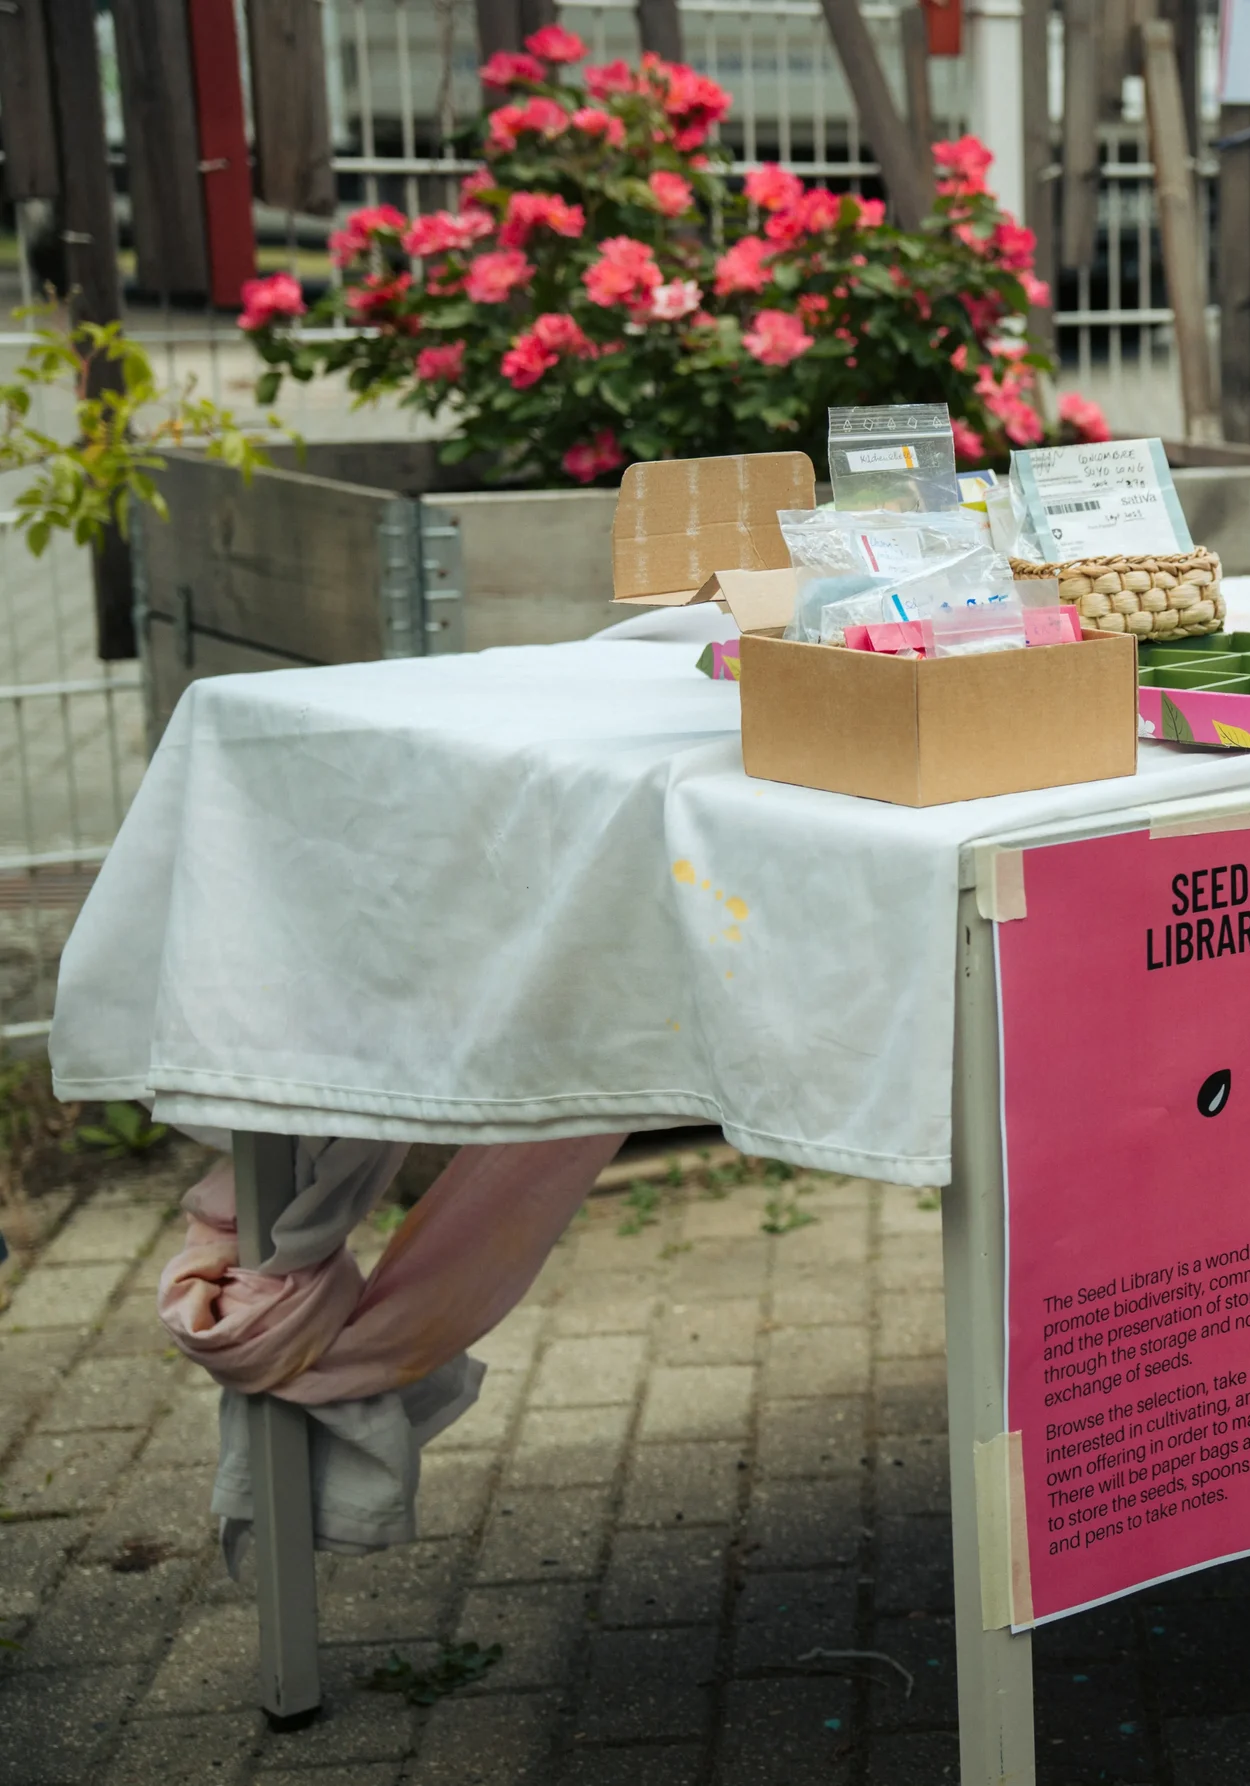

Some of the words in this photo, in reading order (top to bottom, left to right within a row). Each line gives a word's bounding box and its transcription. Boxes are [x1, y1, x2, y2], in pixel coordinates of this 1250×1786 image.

[1120, 490, 1157, 507] sativa
[1171, 863, 1249, 917] SEED
[1043, 1295, 1074, 1314] The
[1077, 1278, 1117, 1305] Seed
[1121, 1266, 1174, 1293] Library
[1177, 1261, 1190, 1277] is
[1192, 1259, 1202, 1273] a
[1043, 1307, 1110, 1343] promote
[1113, 1282, 1205, 1318] biodiversity,
[1043, 1336, 1074, 1361] and
[1078, 1332, 1104, 1351] the
[1107, 1304, 1203, 1347] preservation
[1205, 1294, 1222, 1315] of
[1043, 1351, 1107, 1385] through
[1111, 1346, 1137, 1365] the
[1140, 1328, 1197, 1356] storage
[1200, 1315, 1231, 1339] and
[1044, 1373, 1123, 1408] exchange
[1125, 1362, 1141, 1383] of
[1144, 1351, 1193, 1378] seeds.
[1046, 1412, 1105, 1441] Browse
[1107, 1403, 1134, 1423] the
[1136, 1382, 1209, 1414] selection,
[1212, 1370, 1247, 1391] take
[1046, 1425, 1125, 1464] interested
[1129, 1423, 1143, 1439] in
[1146, 1398, 1231, 1433] cultivating,
[1046, 1465, 1082, 1487] own
[1086, 1445, 1146, 1475] offering
[1150, 1439, 1164, 1455] in
[1167, 1425, 1209, 1449] order
[1212, 1421, 1229, 1436] to
[1047, 1484, 1095, 1509] There
[1098, 1471, 1125, 1494] will
[1128, 1467, 1148, 1485] be
[1151, 1451, 1196, 1481] paper
[1199, 1440, 1239, 1462] bags
[1047, 1516, 1065, 1533] to
[1068, 1503, 1109, 1527] store
[1111, 1494, 1137, 1513] the
[1140, 1476, 1187, 1504] seeds,
[1191, 1459, 1250, 1488] spoons
[1049, 1530, 1081, 1556] and
[1085, 1520, 1124, 1549] pens
[1127, 1514, 1143, 1531] to
[1145, 1502, 1178, 1524] take
[1181, 1488, 1228, 1512] notes.
